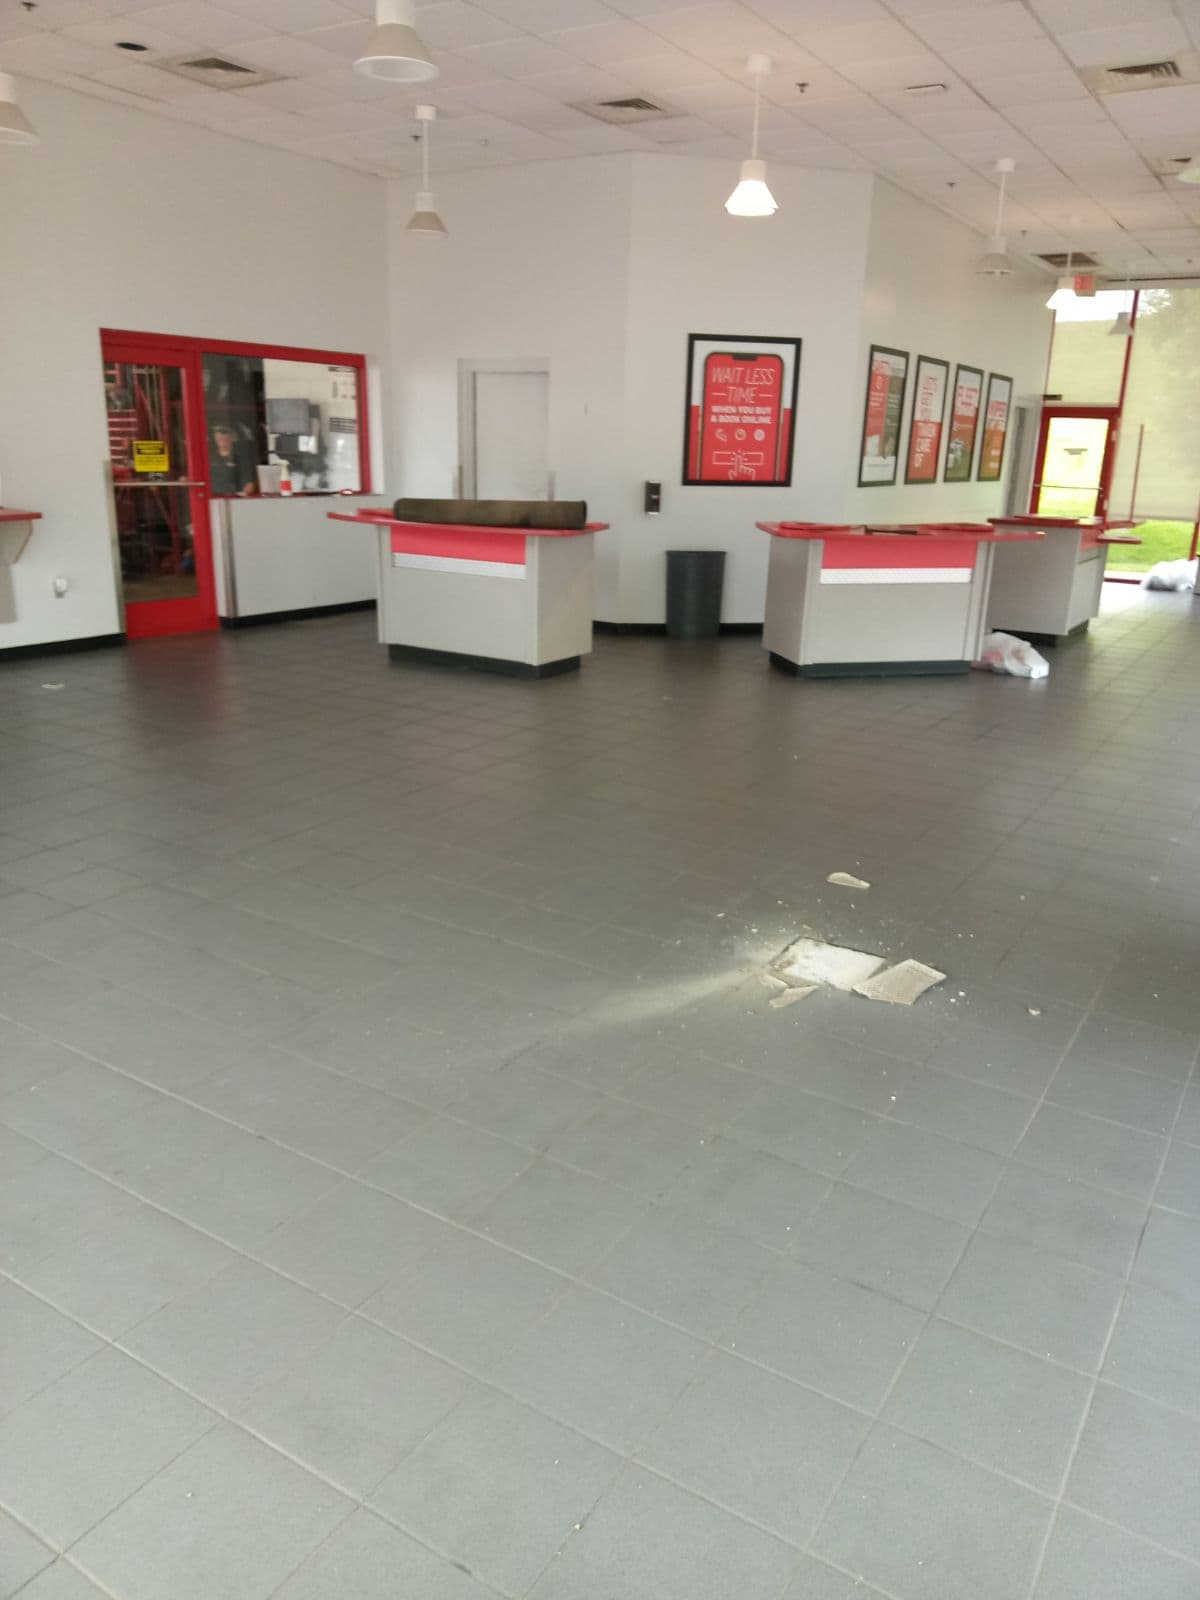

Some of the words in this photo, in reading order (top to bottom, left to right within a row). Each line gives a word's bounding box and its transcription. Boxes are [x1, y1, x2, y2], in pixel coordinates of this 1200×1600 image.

[711, 367, 744, 384] WAIT
[745, 367, 776, 385] LESS
[727, 386, 758, 404] TIME
